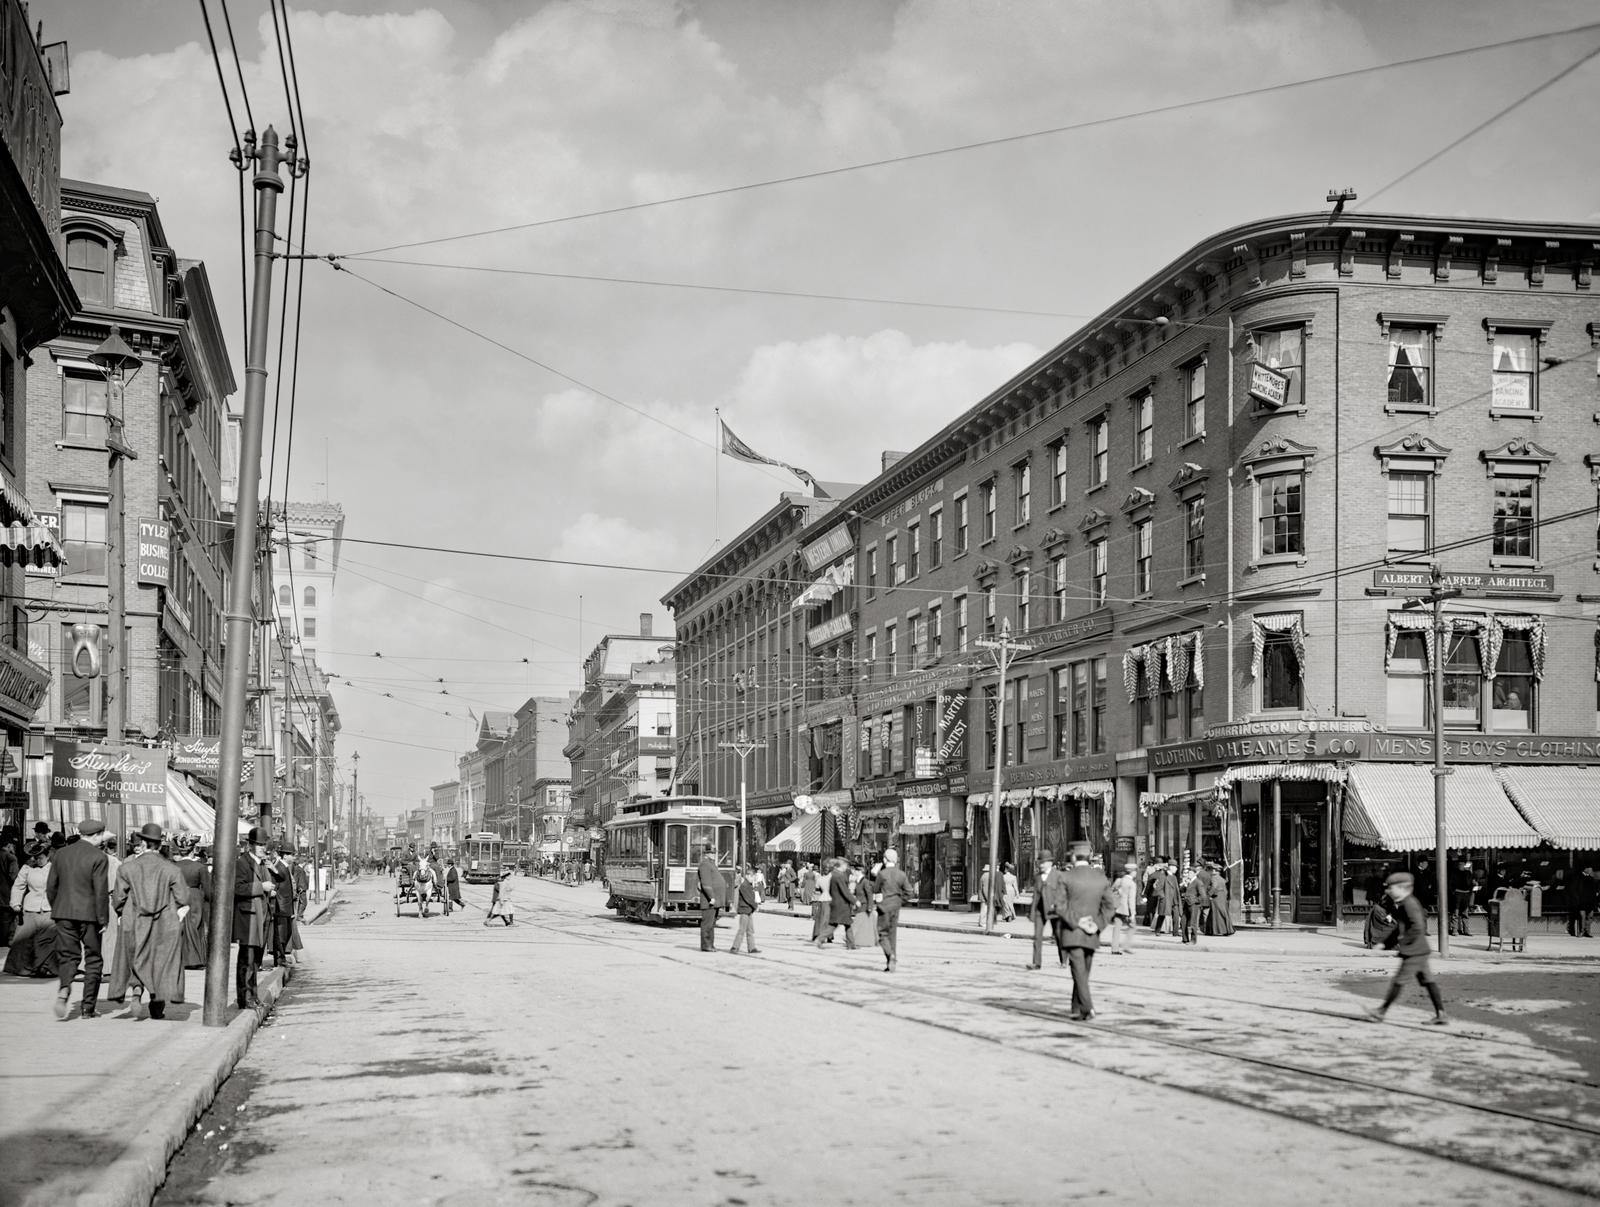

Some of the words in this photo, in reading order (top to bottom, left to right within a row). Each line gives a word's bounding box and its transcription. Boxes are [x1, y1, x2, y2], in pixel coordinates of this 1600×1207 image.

[1252, 381, 1268, 395] DANCING
[1495, 387, 1524, 396] DANCING
[805, 540, 832, 567] WESTERN
[828, 527, 850, 552] UNION
[25, 564, 58, 574] URNISHED.
[1381, 574, 1423, 584] ALBERT
[1214, 722, 1290, 738] HARRINGTON
[940, 719, 967, 759] DENTIST
[1374, 738, 1432, 756] MEN'S
[1459, 739, 1511, 757] BOYS'
[68, 748, 152, 781] Huyler's
[54, 776, 98, 790] BONBONS
[1010, 769, 1035, 783] BEMIS
[1037, 770, 1043, 779] &
[684, 805, 710, 813] BELMONT
